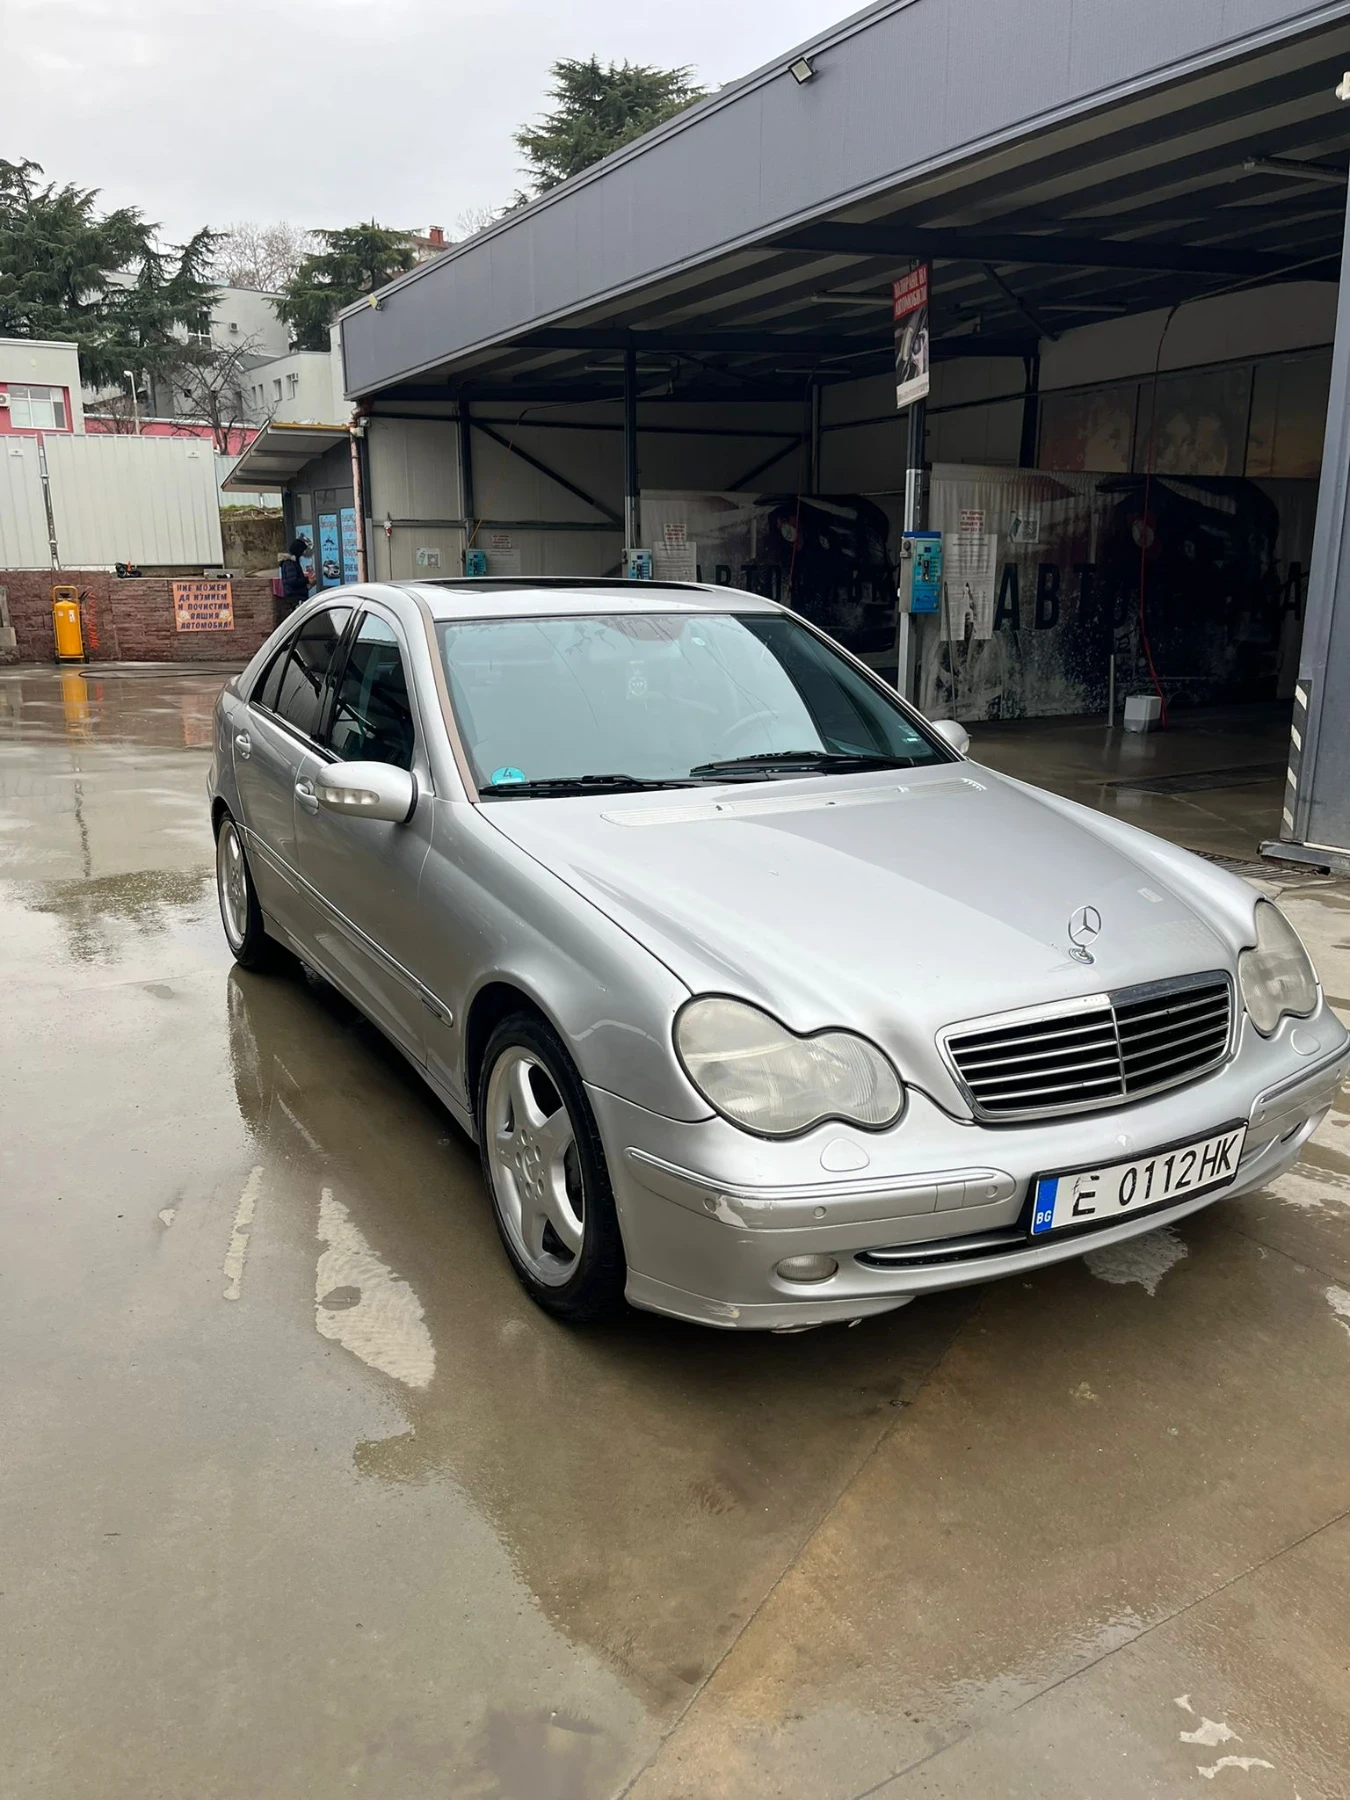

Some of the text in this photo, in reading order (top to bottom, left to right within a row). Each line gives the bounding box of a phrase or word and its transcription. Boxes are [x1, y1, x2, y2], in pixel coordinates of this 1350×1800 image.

[179, 593, 227, 602] ДА ИЗМИЕМ
[190, 612, 220, 620] ВАШИЯ
[503, 767, 513, 778] 4
[1072, 1175, 1100, 1217] E
[1036, 1211, 1052, 1225] BG
